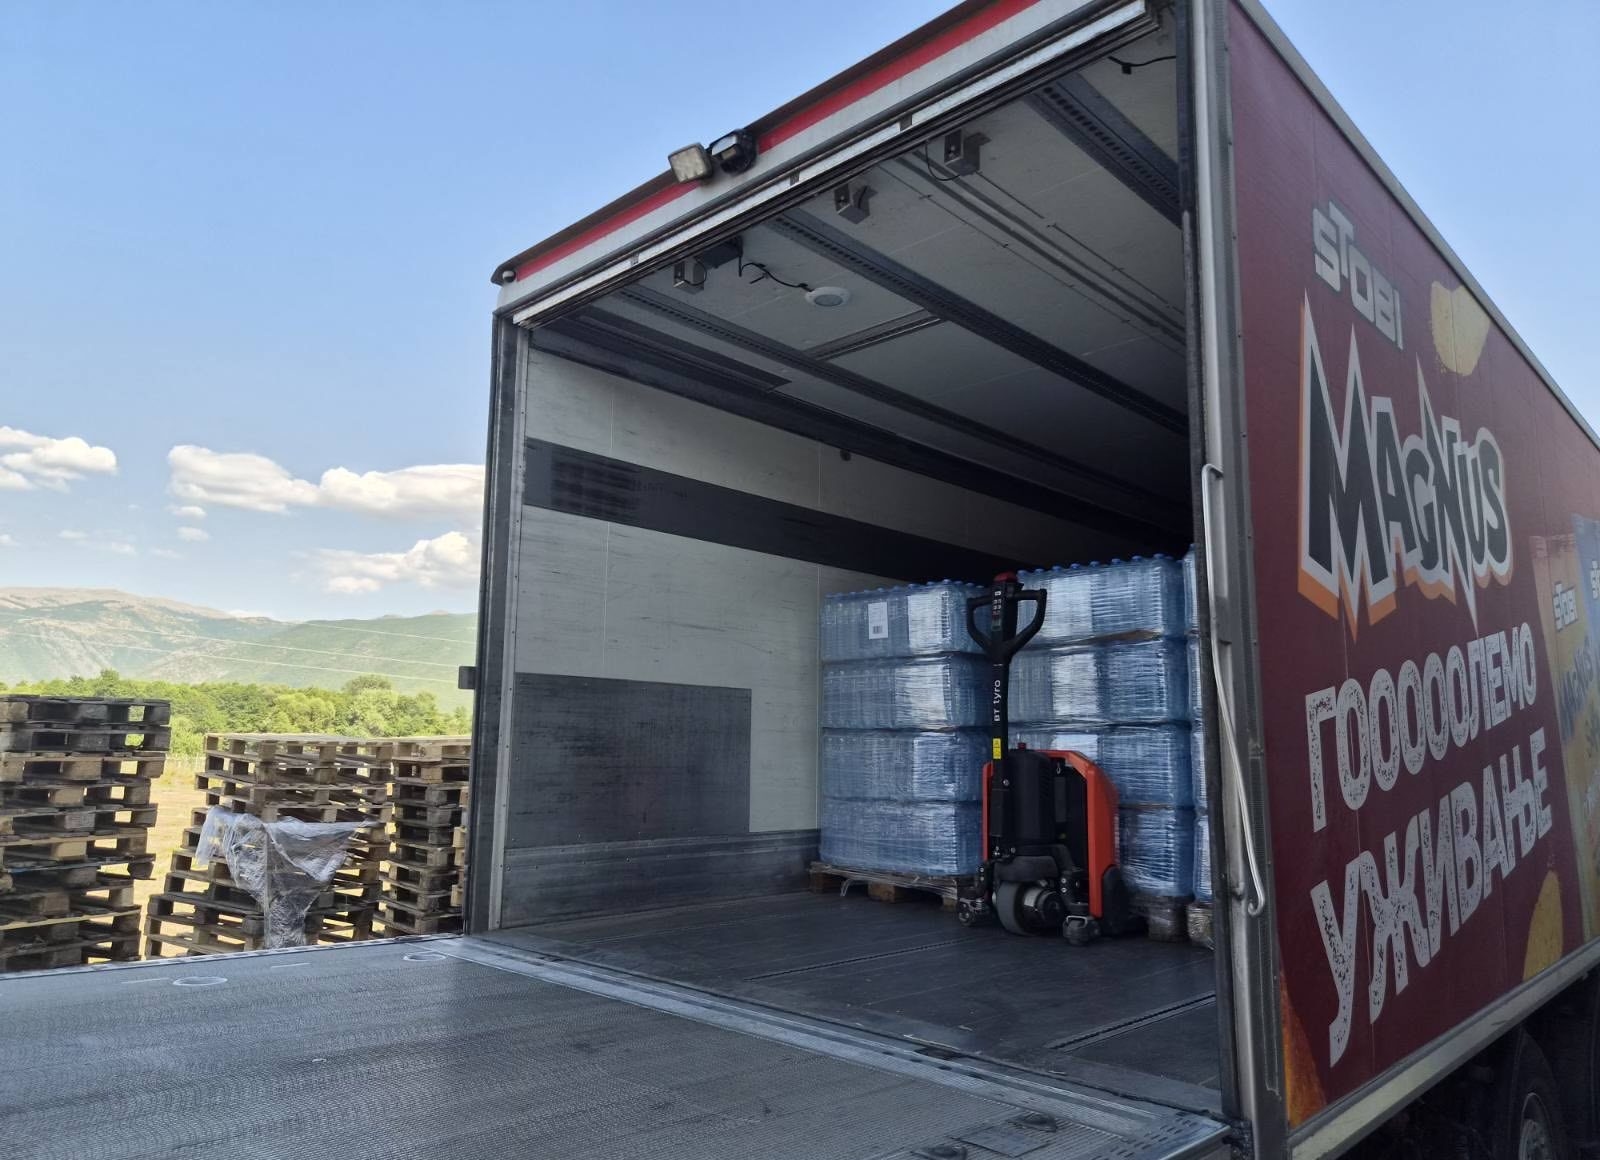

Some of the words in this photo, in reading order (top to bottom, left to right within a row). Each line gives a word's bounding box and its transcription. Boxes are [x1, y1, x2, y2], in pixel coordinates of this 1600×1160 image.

[1299, 288, 1513, 640] MAGNUS
[993, 708, 1000, 721] BT
[1304, 622, 1537, 833] ГОООООЛЕМО
[1310, 727, 1553, 1069] УЖИВАЊЕ
